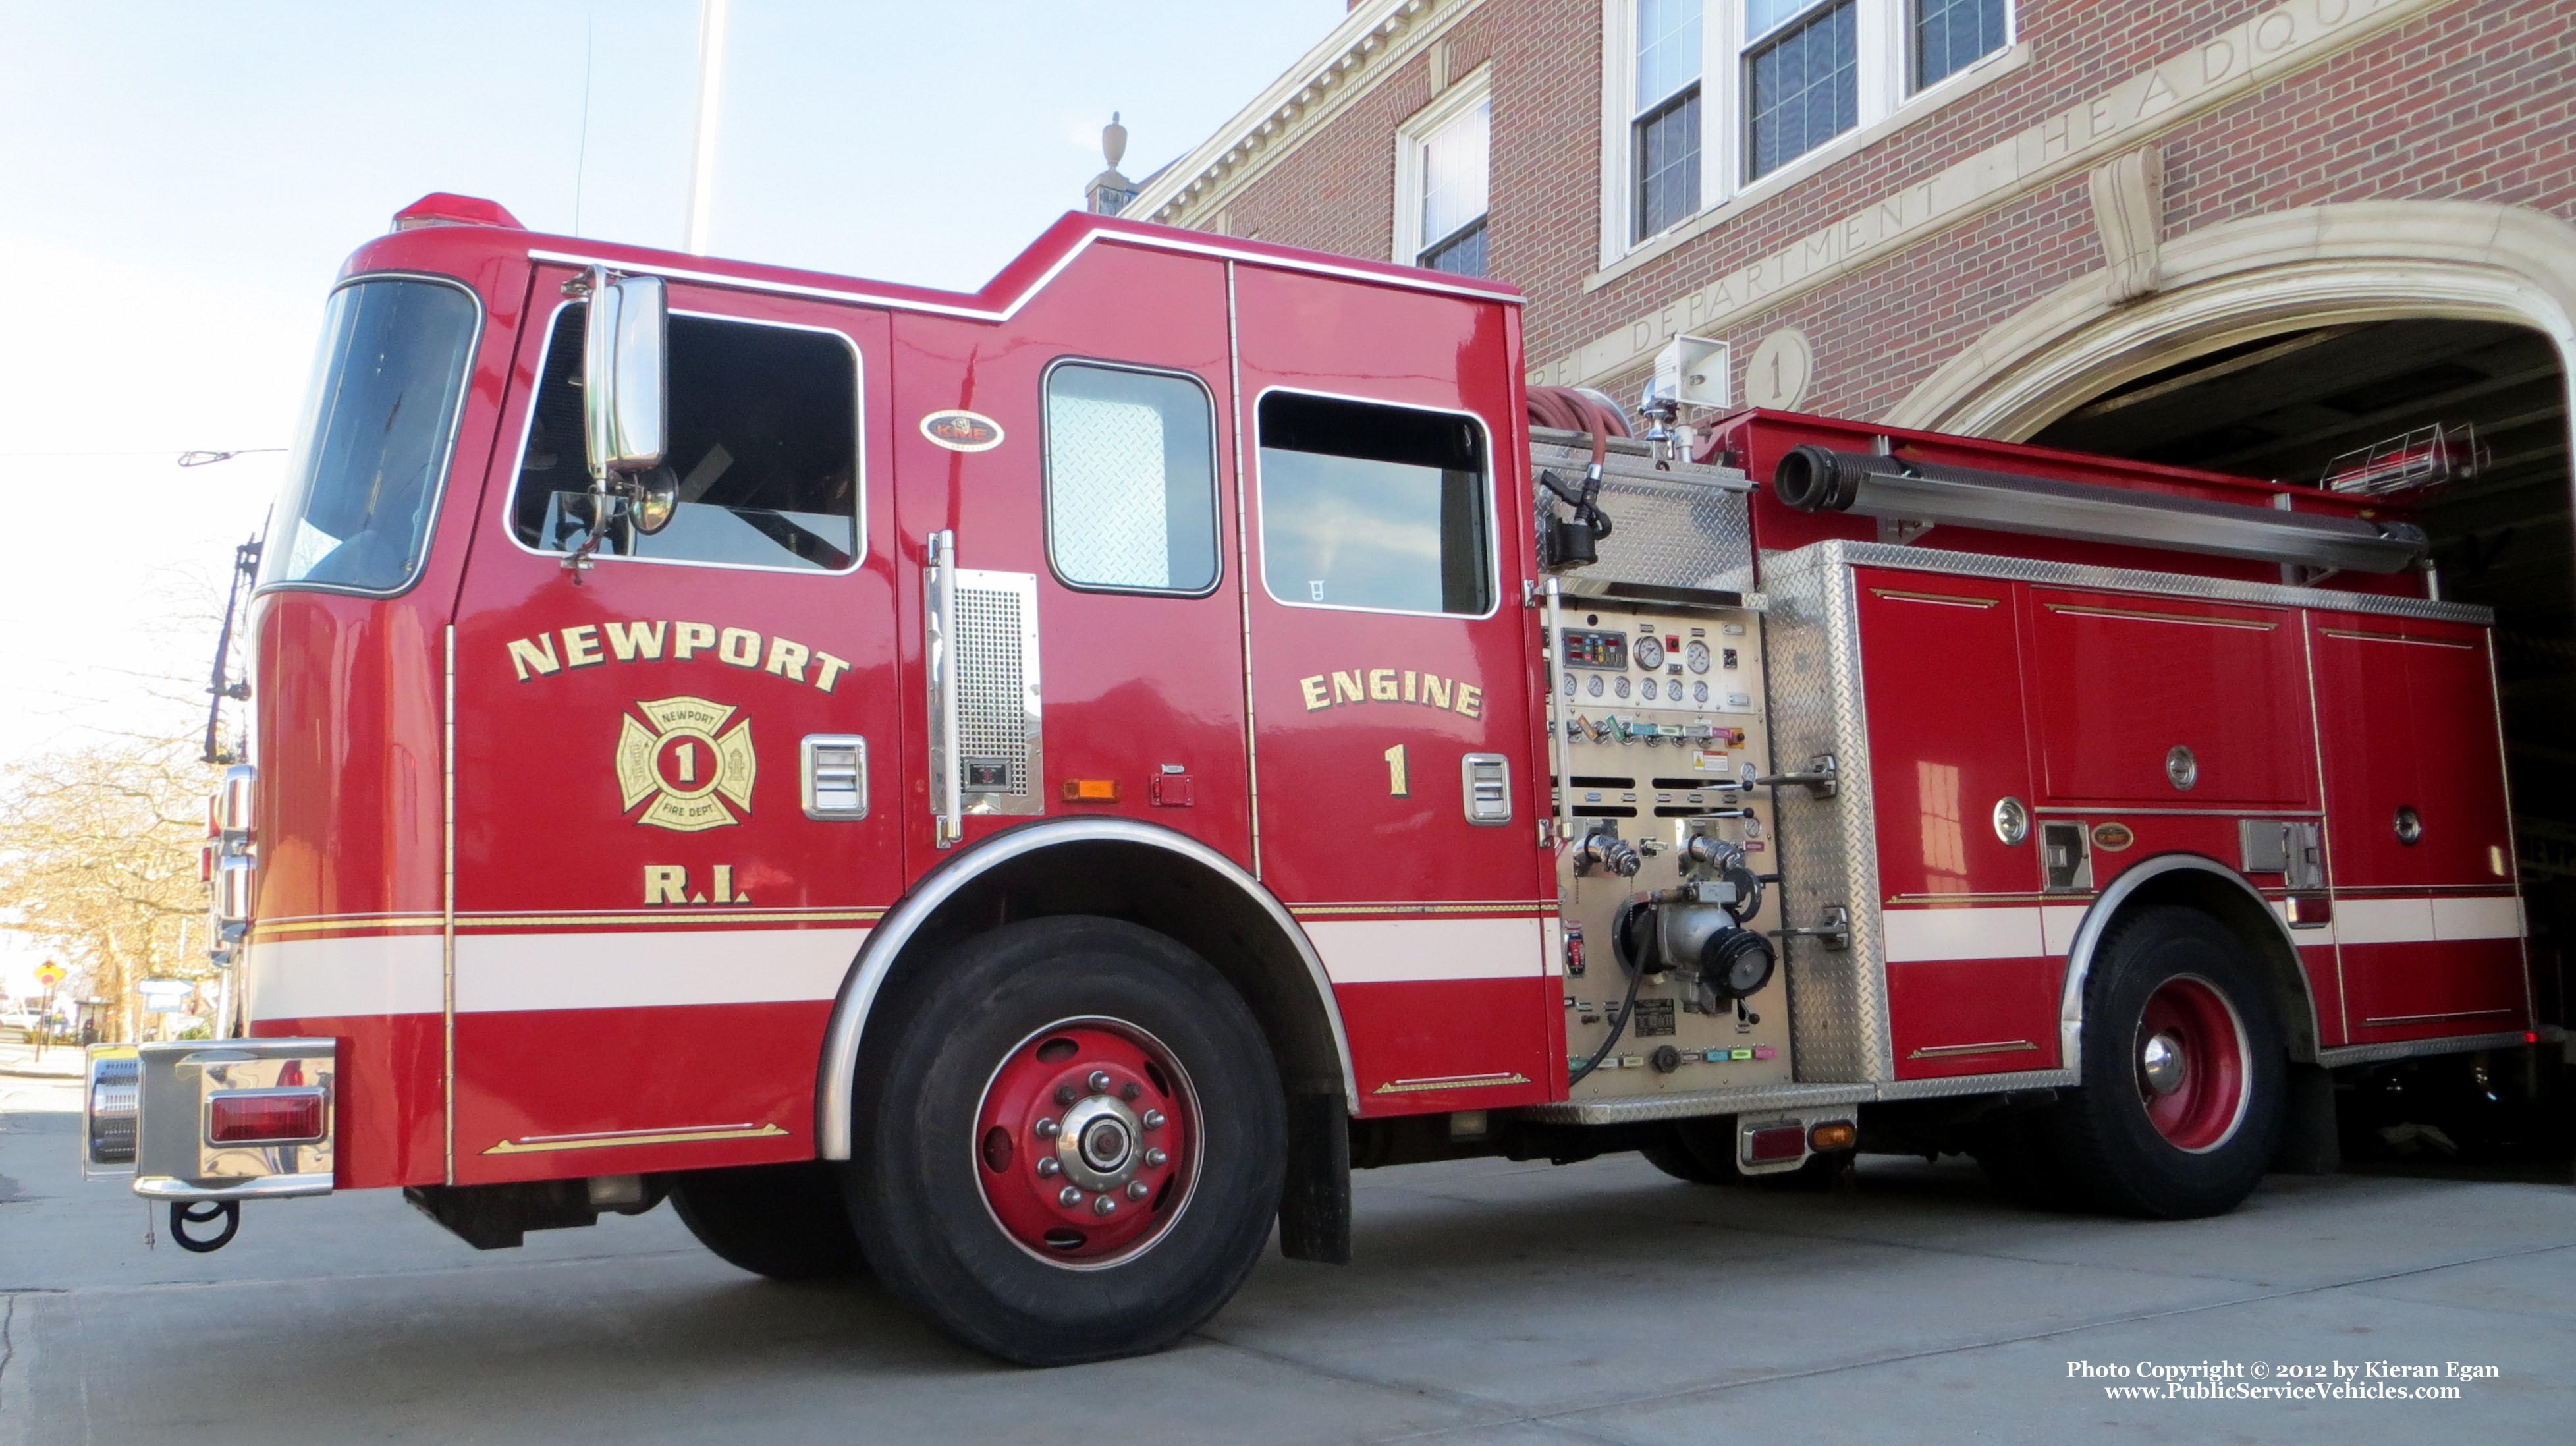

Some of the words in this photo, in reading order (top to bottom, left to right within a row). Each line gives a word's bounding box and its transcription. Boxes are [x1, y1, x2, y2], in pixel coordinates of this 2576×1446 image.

[1632, 177, 1941, 354] DEPARTMENT
[2041, 0, 2380, 162] HEADQU
[1770, 350, 1782, 400] 1
[507, 621, 851, 694] NEWPORT
[661, 710, 715, 725] NEWPORT
[1299, 668, 1483, 718] ENGINE
[675, 742, 696, 783] 1
[1384, 744, 1408, 796] 1
[663, 803, 685, 817] FIRE
[644, 865, 751, 905] R.I.
